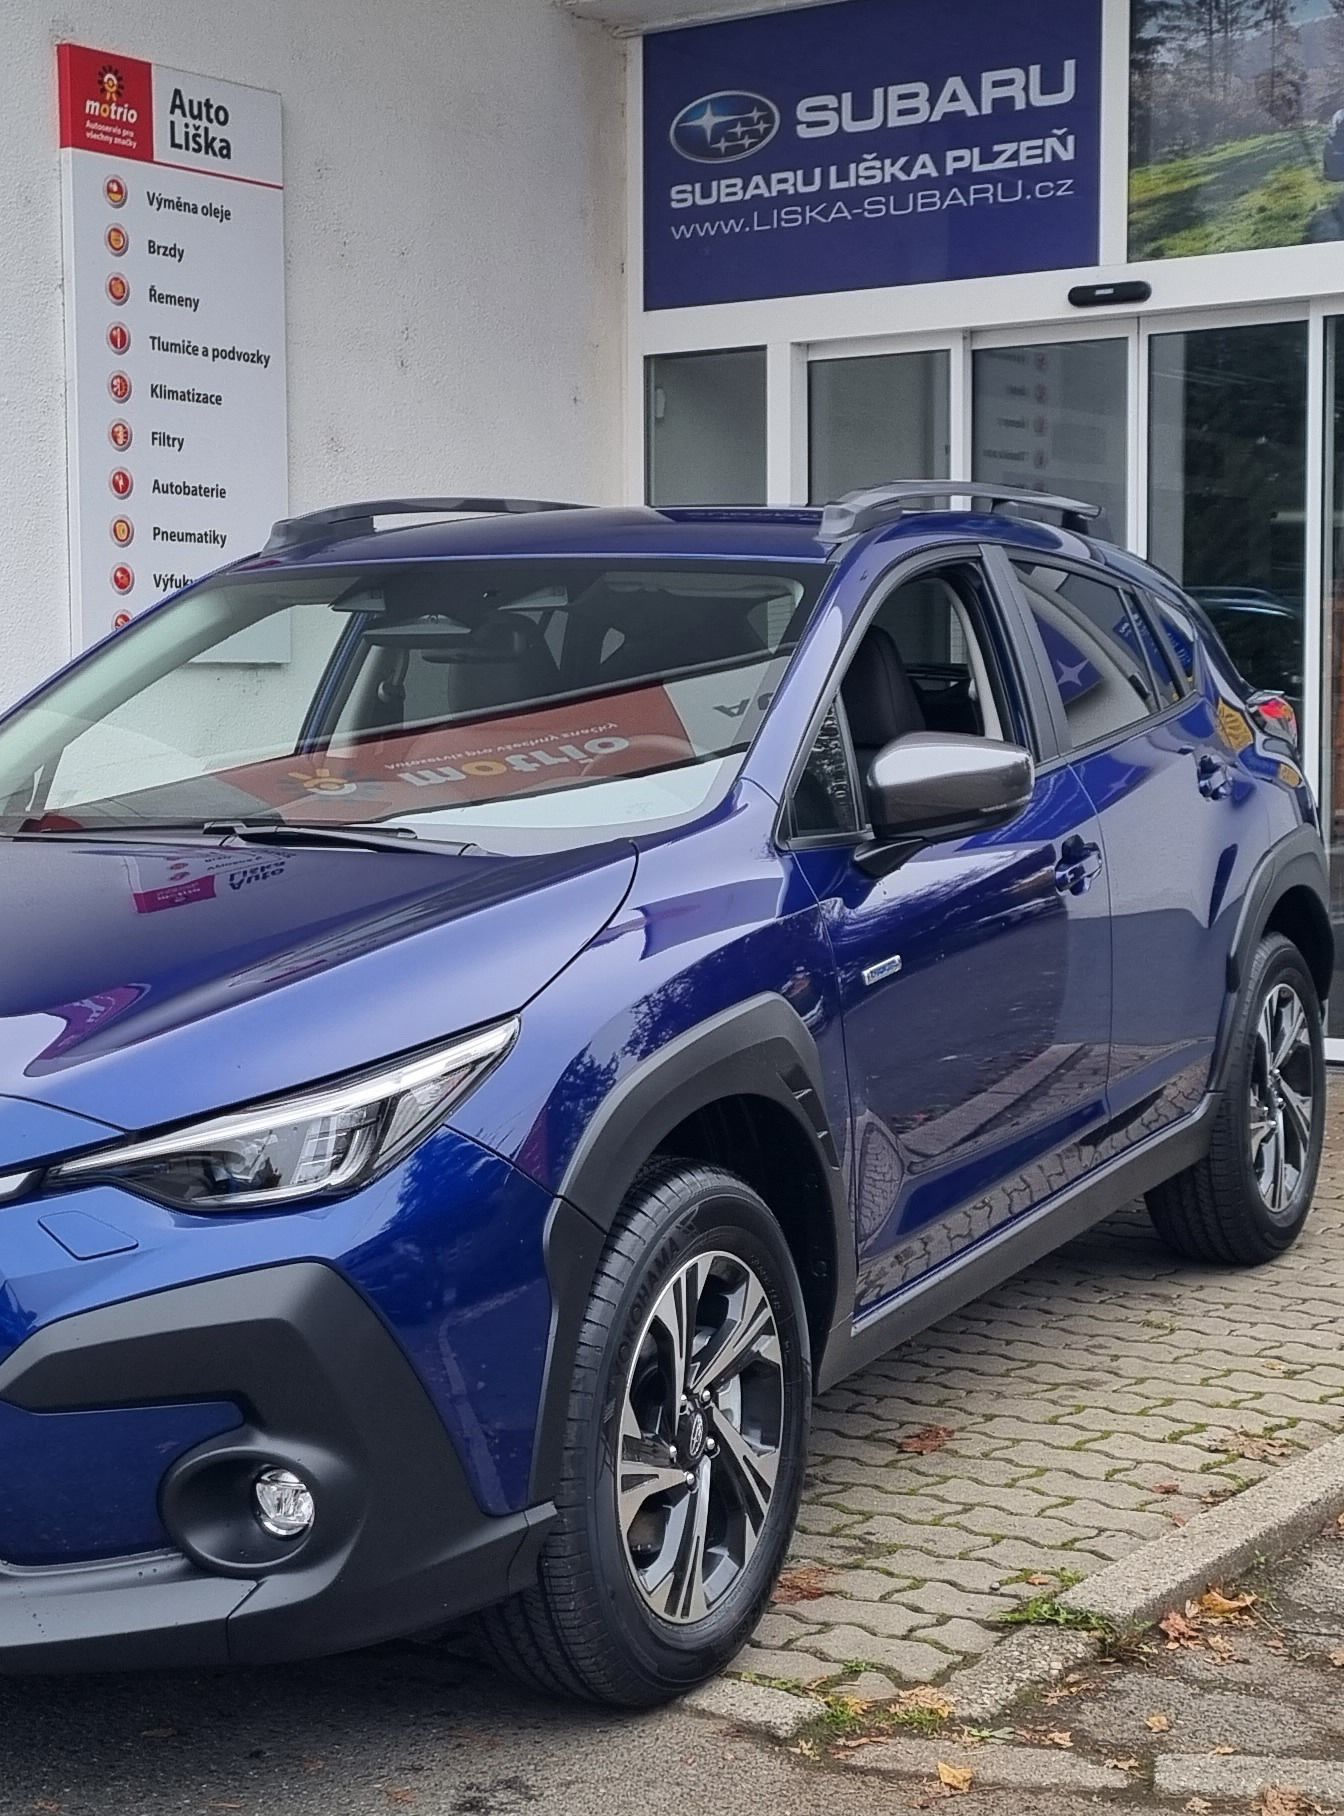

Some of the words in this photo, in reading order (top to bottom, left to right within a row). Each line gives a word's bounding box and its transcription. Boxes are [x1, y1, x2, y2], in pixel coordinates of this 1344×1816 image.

[85, 99, 138, 124] motrio
[170, 88, 230, 126] Auto
[796, 59, 1076, 139] SUBARU
[170, 121, 232, 159] Liška
[670, 168, 822, 209] SUBARU
[830, 152, 939, 191] LIŠKA
[946, 127, 1075, 175] PLZEŇ
[147, 190, 199, 215] Výměna
[201, 201, 232, 222] oleje
[671, 179, 1075, 239] www.LISKA-SUBARU.cz
[148, 240, 185, 263] Brzdy
[149, 285, 200, 312] Řemeny
[149, 335, 199, 357] Tlumiče
[202, 347, 208, 357] a
[212, 346, 271, 368] podvozky
[150, 383, 223, 406] Klimatizace
[151, 431, 185, 452] Filtry
[152, 479, 227, 499] Autobaterie
[153, 526, 227, 548] Pneumatiky
